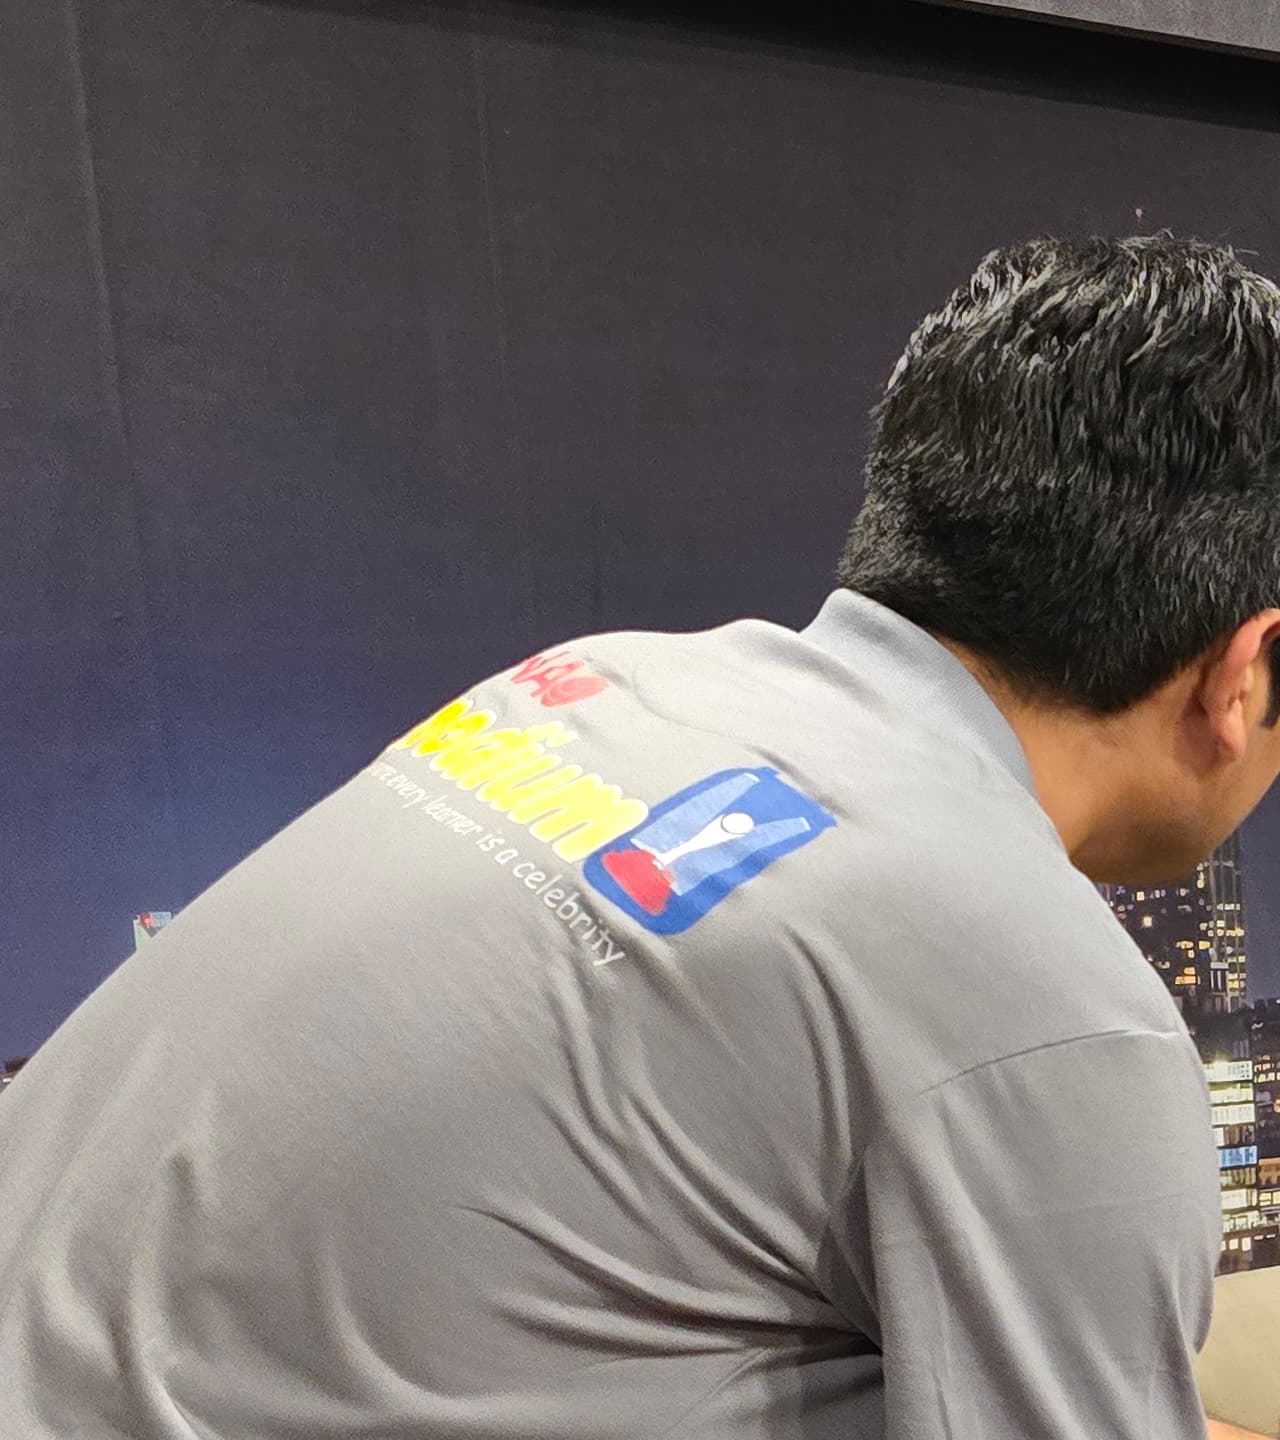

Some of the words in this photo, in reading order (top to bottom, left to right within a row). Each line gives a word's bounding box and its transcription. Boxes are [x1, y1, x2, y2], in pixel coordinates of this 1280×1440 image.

[476, 831, 505, 852] is
[495, 849, 519, 865] a
[513, 862, 625, 966] celebrity
